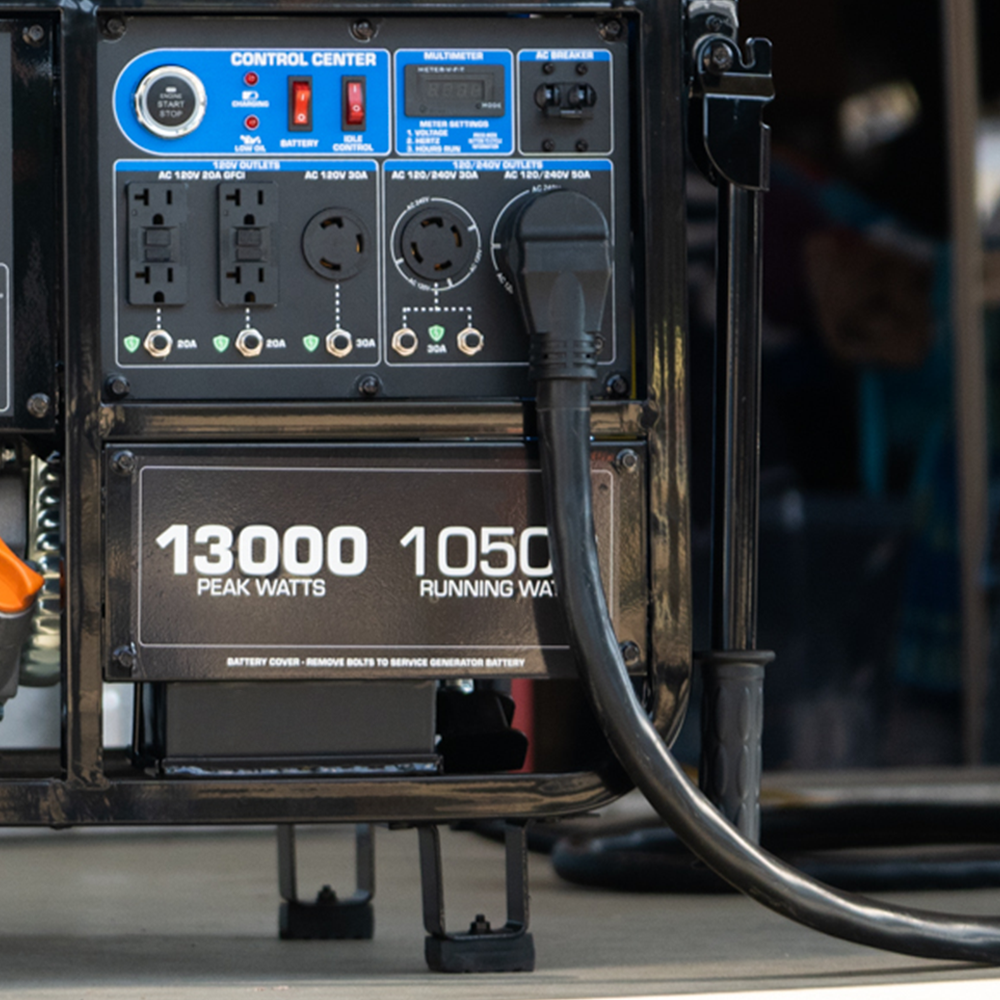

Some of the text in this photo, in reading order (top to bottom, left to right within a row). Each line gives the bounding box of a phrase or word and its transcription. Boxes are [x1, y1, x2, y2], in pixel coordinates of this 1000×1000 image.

[231, 52, 377, 66] CONTROL CENTER
[424, 52, 484, 60] MULTIMETER
[535, 52, 594, 60] AC BREAKER
[157, 100, 185, 108] START
[159, 110, 183, 118] STOP
[419, 120, 489, 128] METER SETTINGS
[280, 139, 319, 148] BATTERY
[343, 135, 363, 143] IDLE
[332, 143, 374, 152] CONTROL
[213, 161, 280, 170] 120V OUTLETS
[453, 161, 544, 170] 120/240V OUTLETS
[158, 171, 246, 180] AC 120V 20A GFCI
[304, 171, 368, 180] AC 120V 30A
[391, 171, 479, 180] AC 120/240V 30A
[504, 171, 591, 180] AC 120/240V 50A
[177, 340, 198, 349] 20A
[266, 340, 287, 349] 20A
[355, 339, 376, 348] 30A
[427, 344, 447, 354] 30A
[155, 524, 368, 577] 13000
[400, 525, 554, 577] 1050
[196, 578, 326, 597] PEAK WATTS
[420, 579, 514, 597] RUNNING
[227, 657, 267, 667] BATTERY
[268, 657, 300, 667] COVER
[306, 658, 345, 667] REMOVE
[347, 658, 375, 667] BOLTS
[376, 658, 388, 667] TO
[390, 658, 428, 667] SERVICE
[429, 658, 484, 668] GENERATOR
[485, 658, 525, 668] BATTERY
